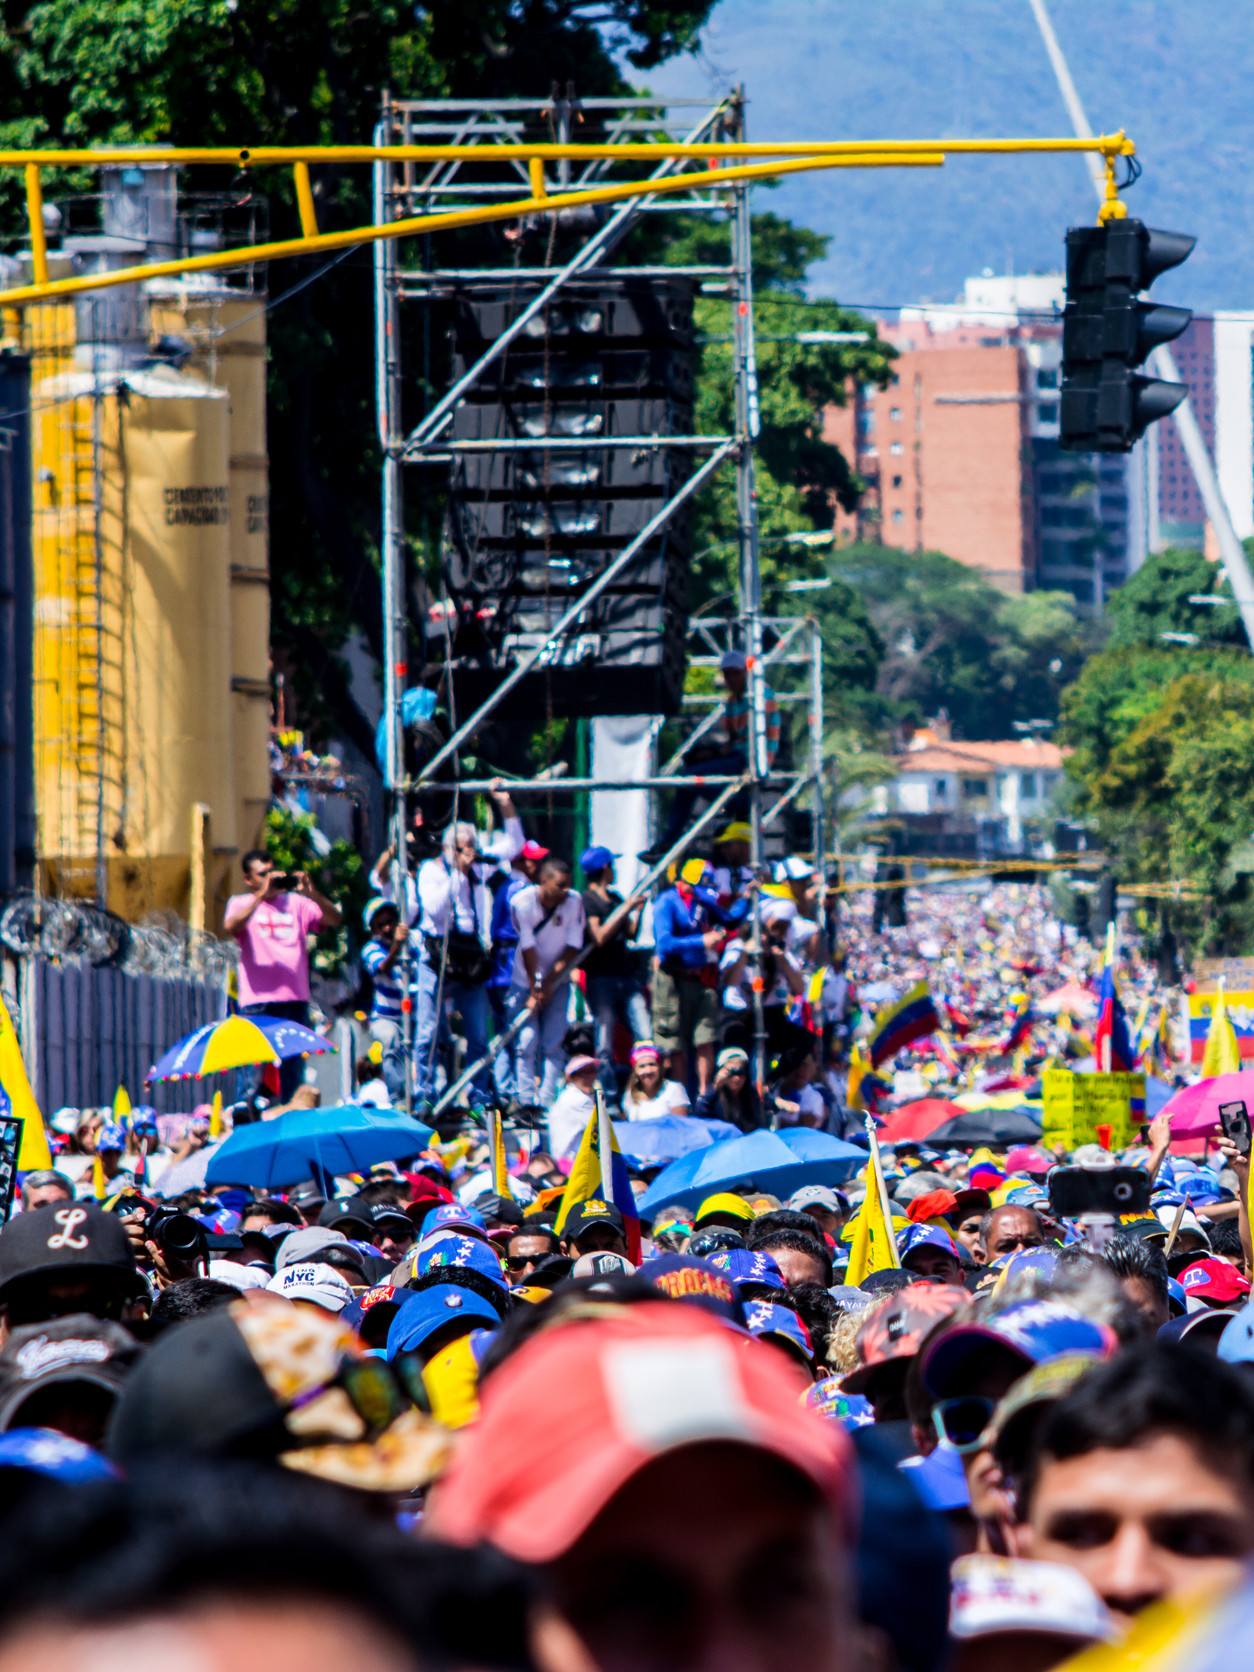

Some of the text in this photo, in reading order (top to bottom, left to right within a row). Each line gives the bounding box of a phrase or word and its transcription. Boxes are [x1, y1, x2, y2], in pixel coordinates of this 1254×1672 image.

[47, 1208, 89, 1249] L
[283, 1270, 316, 1285] NYC
[283, 1281, 315, 1290] MARATHON
